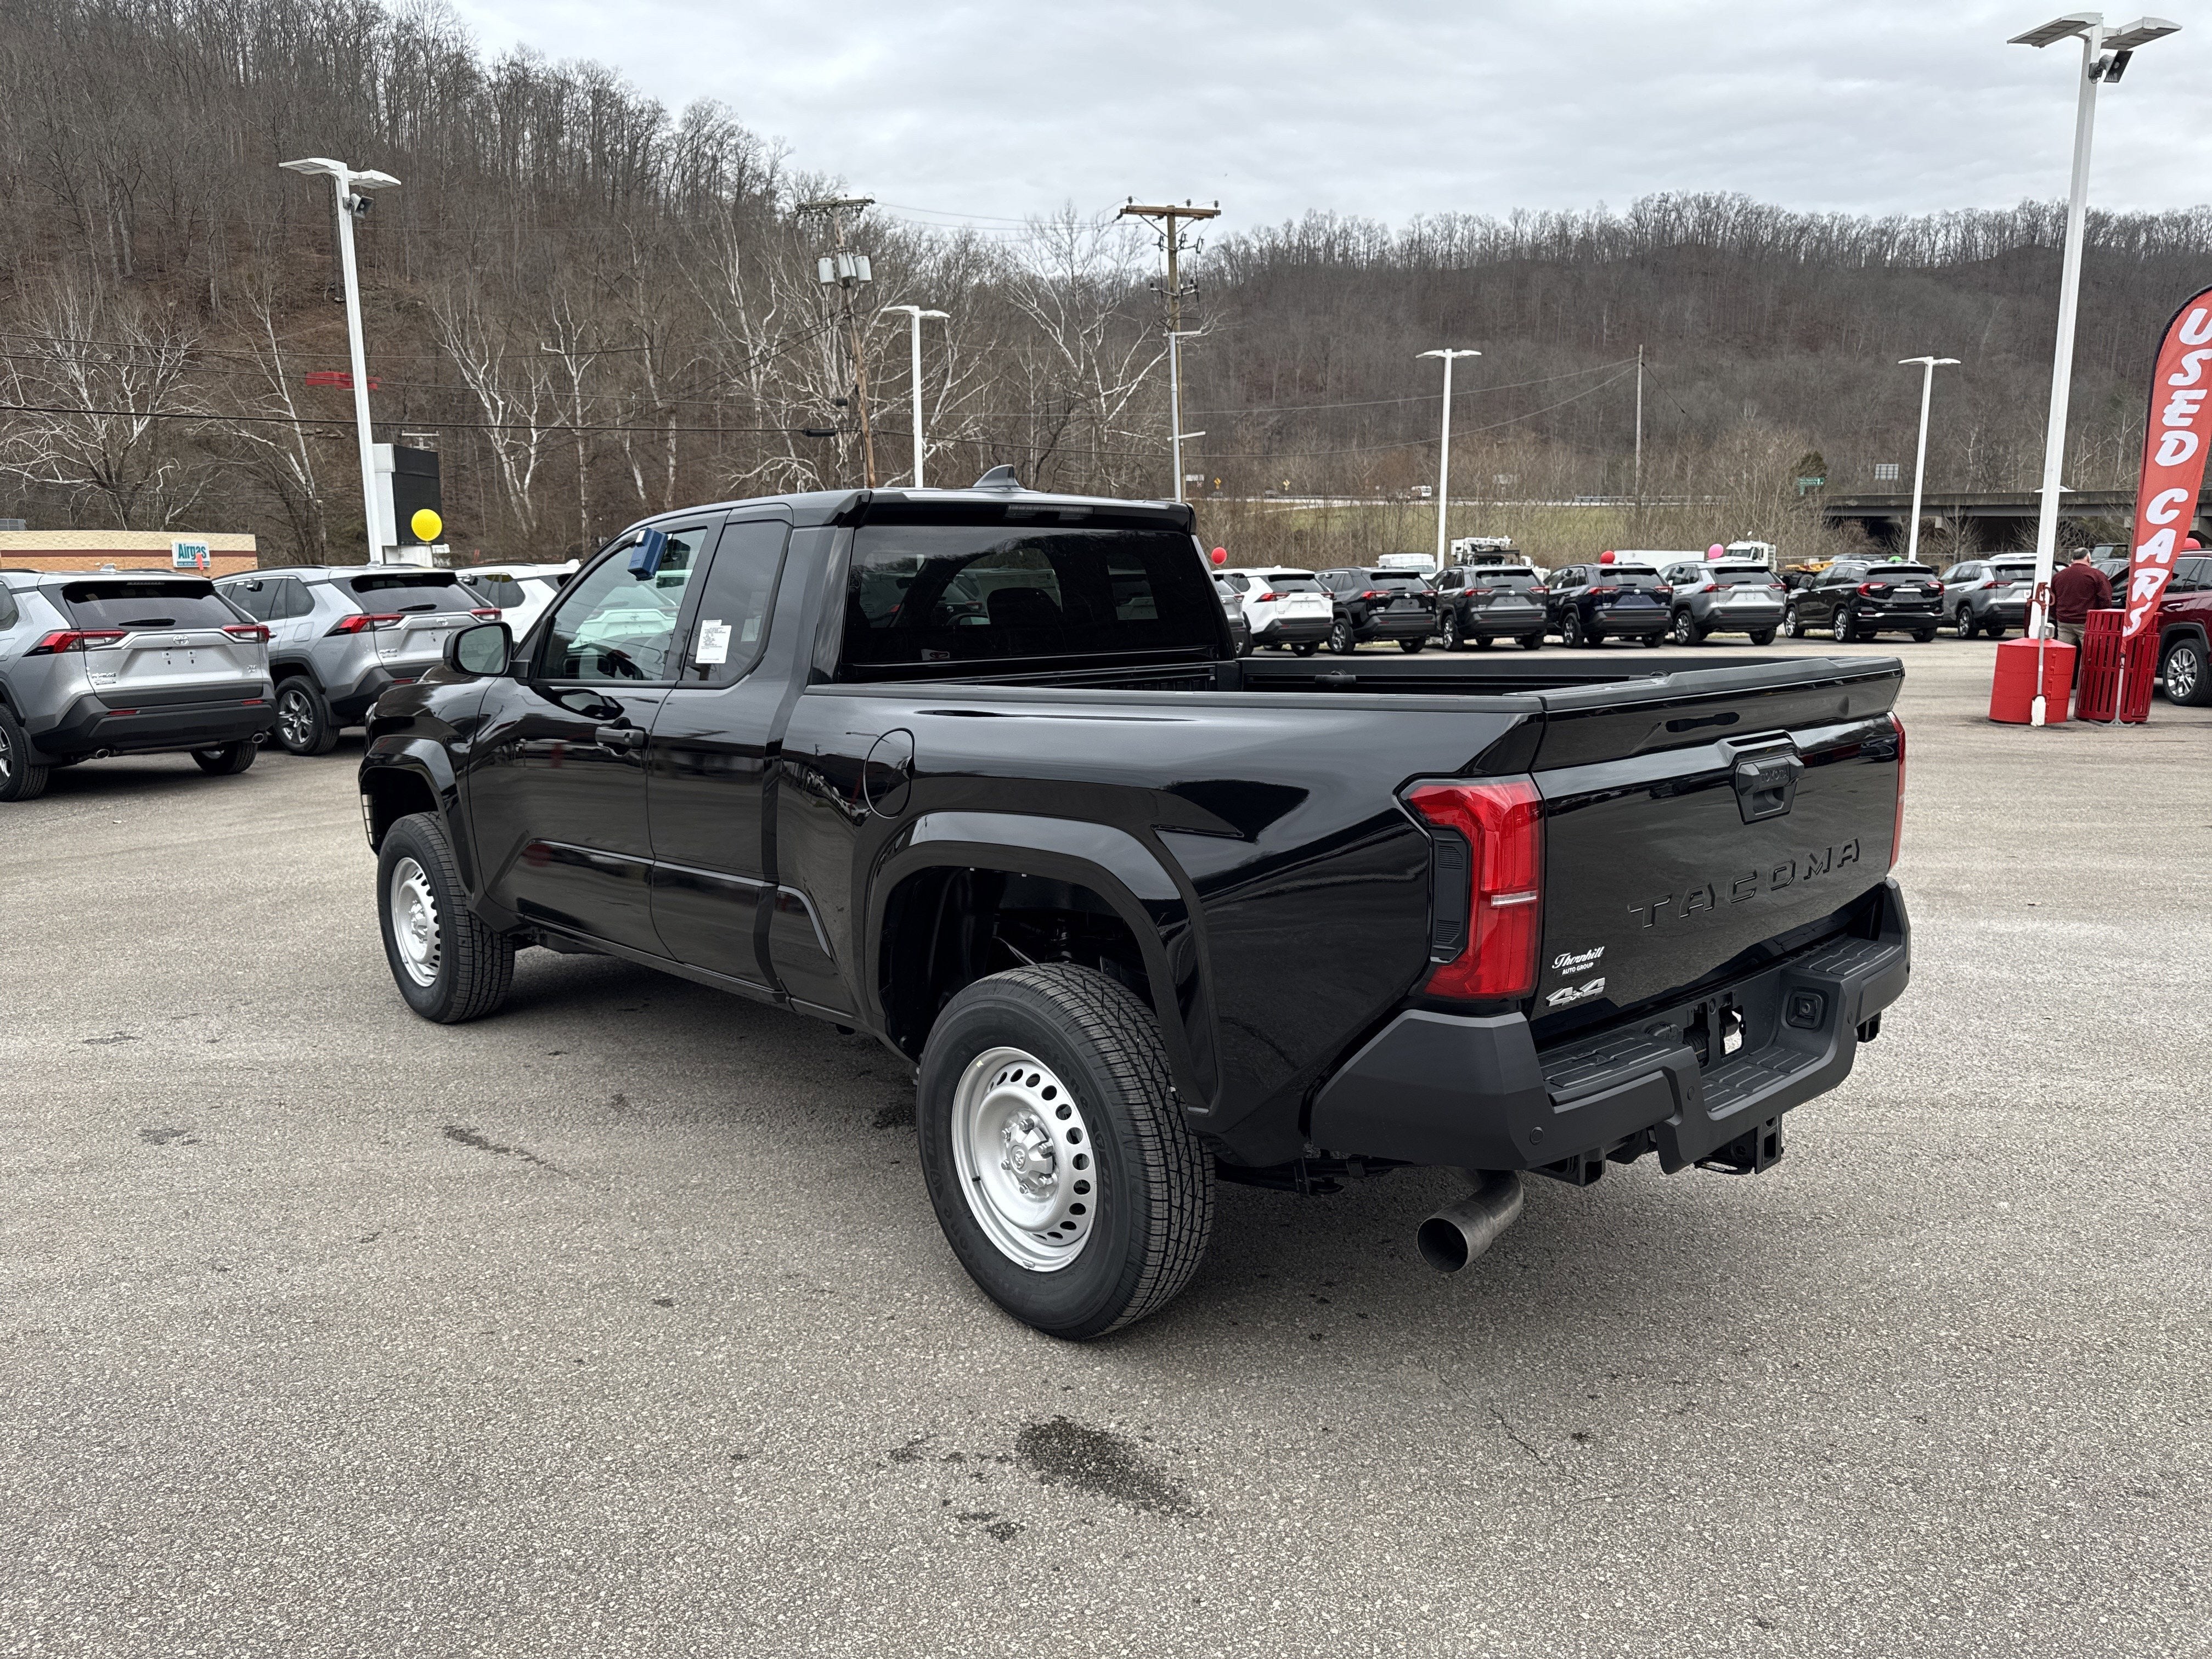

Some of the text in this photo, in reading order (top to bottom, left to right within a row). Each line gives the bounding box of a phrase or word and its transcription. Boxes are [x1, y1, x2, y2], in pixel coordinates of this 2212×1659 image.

[2123, 307, 2212, 637] USED CARS
[178, 543, 207, 560] Airgas
[1758, 769, 1788, 783] TOYOTA
[1627, 838, 1860, 929] TACOMA
[1551, 946, 1605, 969] Thornhill
[1561, 962, 1594, 975] AUTO GROUP
[1545, 977, 1605, 1007] 4x4
